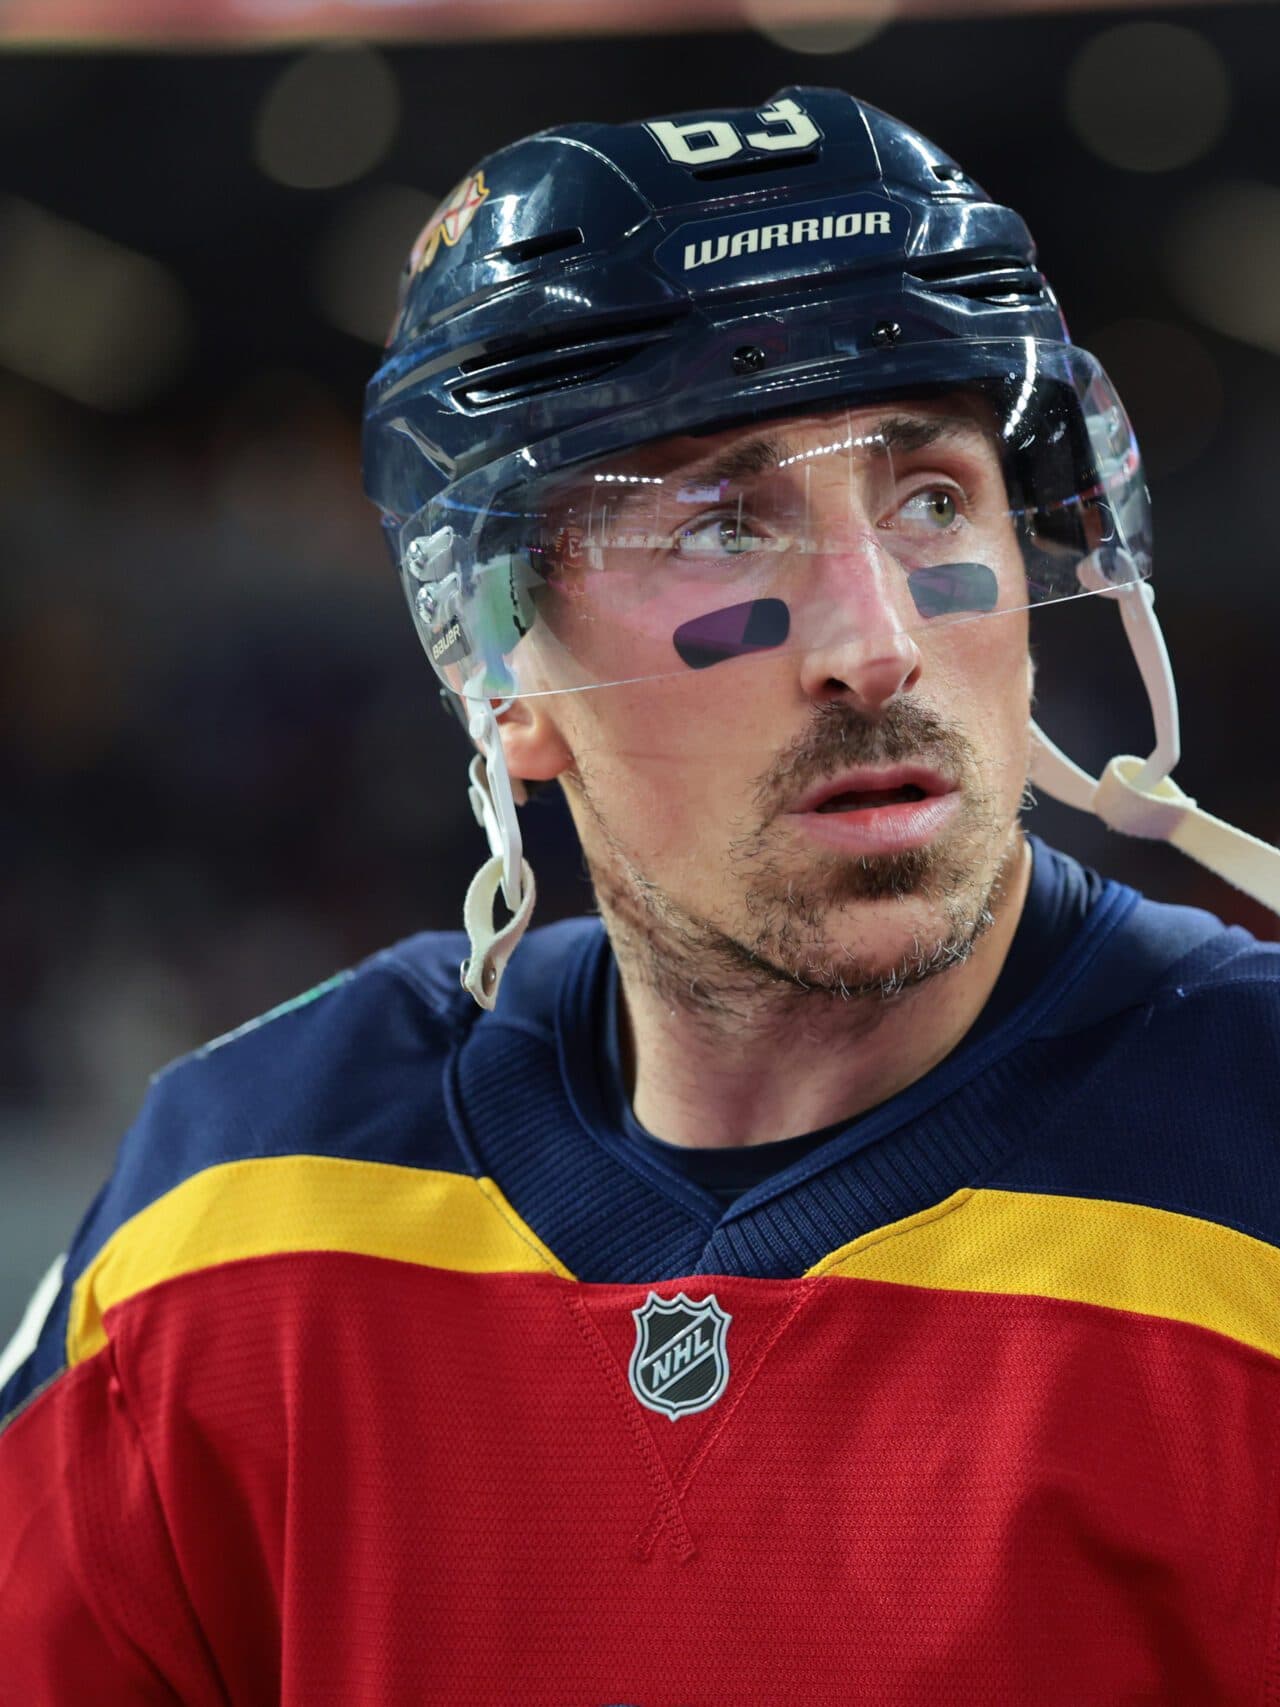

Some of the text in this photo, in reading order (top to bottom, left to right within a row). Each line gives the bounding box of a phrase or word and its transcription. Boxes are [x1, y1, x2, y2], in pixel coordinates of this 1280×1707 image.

[683, 211, 892, 271] WARRIOR
[432, 623, 461, 660] BAUER
[652, 1327, 710, 1389] NHL
